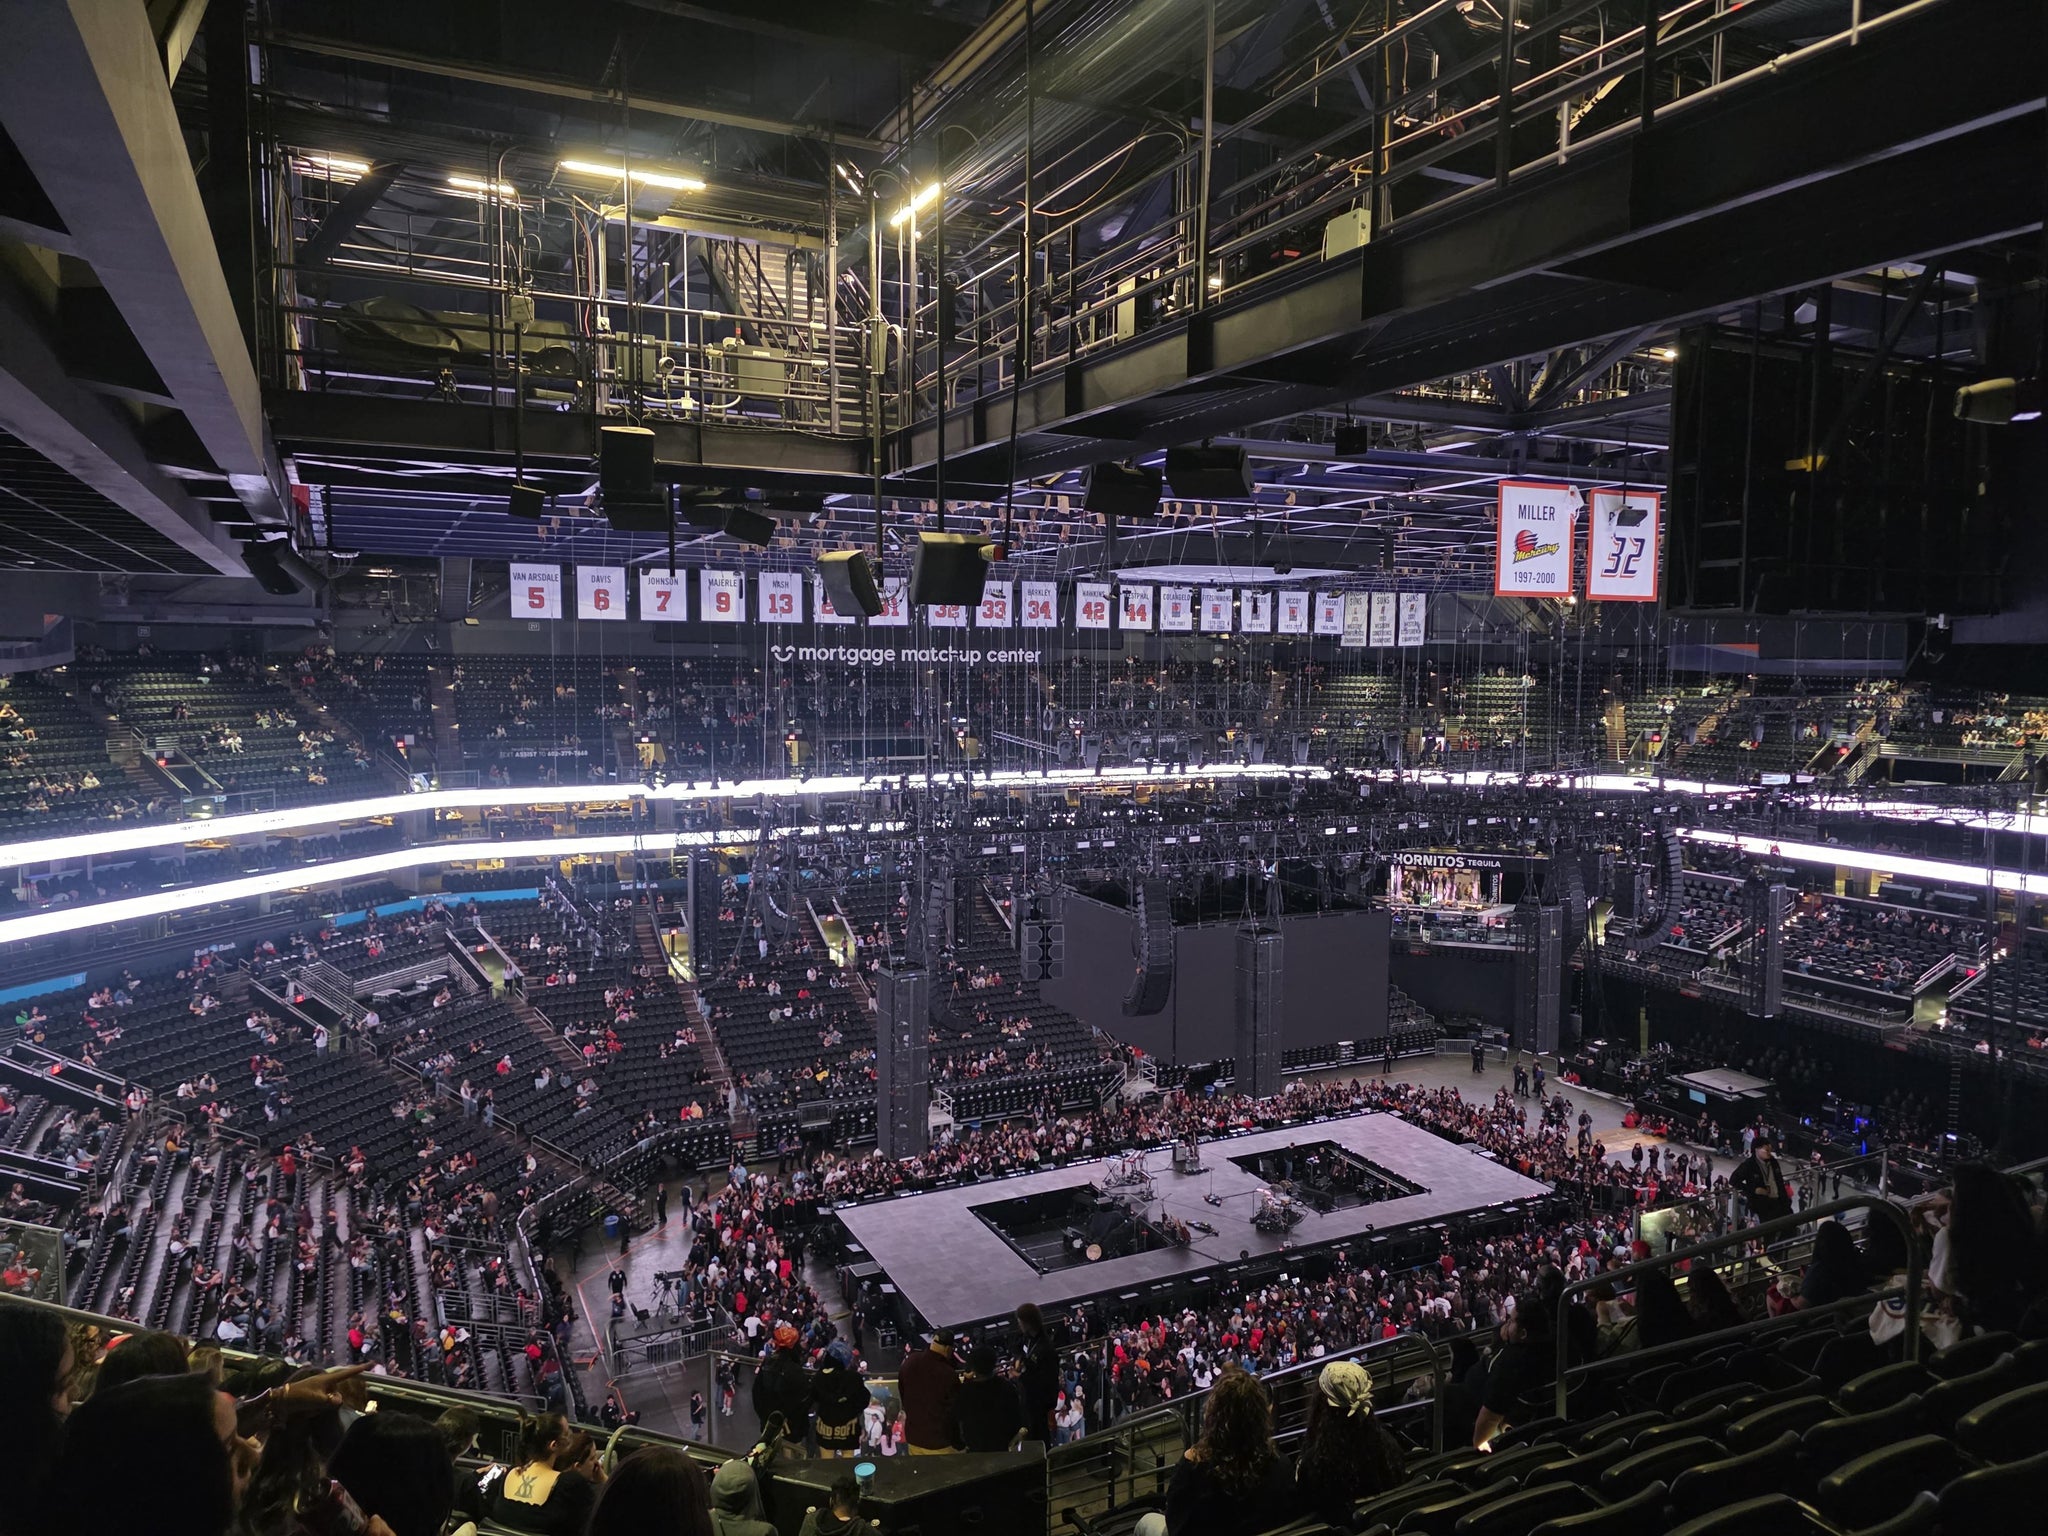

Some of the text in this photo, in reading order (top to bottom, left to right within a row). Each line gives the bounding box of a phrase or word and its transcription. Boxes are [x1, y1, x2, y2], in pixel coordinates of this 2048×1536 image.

[1518, 504, 1555, 521] MILLER
[1515, 543, 1559, 562] Mercury
[1601, 537, 1645, 577] 32
[512, 572, 559, 582] VAN ARSDALE
[591, 575, 611, 584] DAVIS
[648, 577, 679, 586] JOHNSON
[708, 578, 737, 587] MAJERLE
[772, 580, 789, 589] NASH
[1514, 571, 1555, 584] 1997-2000
[528, 586, 545, 609] 5
[594, 588, 610, 611] 6
[656, 590, 671, 612] 7
[1027, 588, 1052, 597] BARKLEY
[1127, 592, 1150, 600] ESTPHAL
[1376, 597, 1390, 605] SUNS
[716, 592, 731, 613] 9
[768, 593, 794, 614] 13
[982, 600, 1007, 619] 33
[1027, 600, 1052, 620] 34
[1082, 601, 1105, 620] 42
[1125, 603, 1147, 622] 44
[799, 645, 1041, 666] mortgage matchup center
[1393, 853, 1465, 868] HORNITOS
[1467, 859, 1501, 868] TEQUILA
[194, 942, 236, 957] Bell Bank
